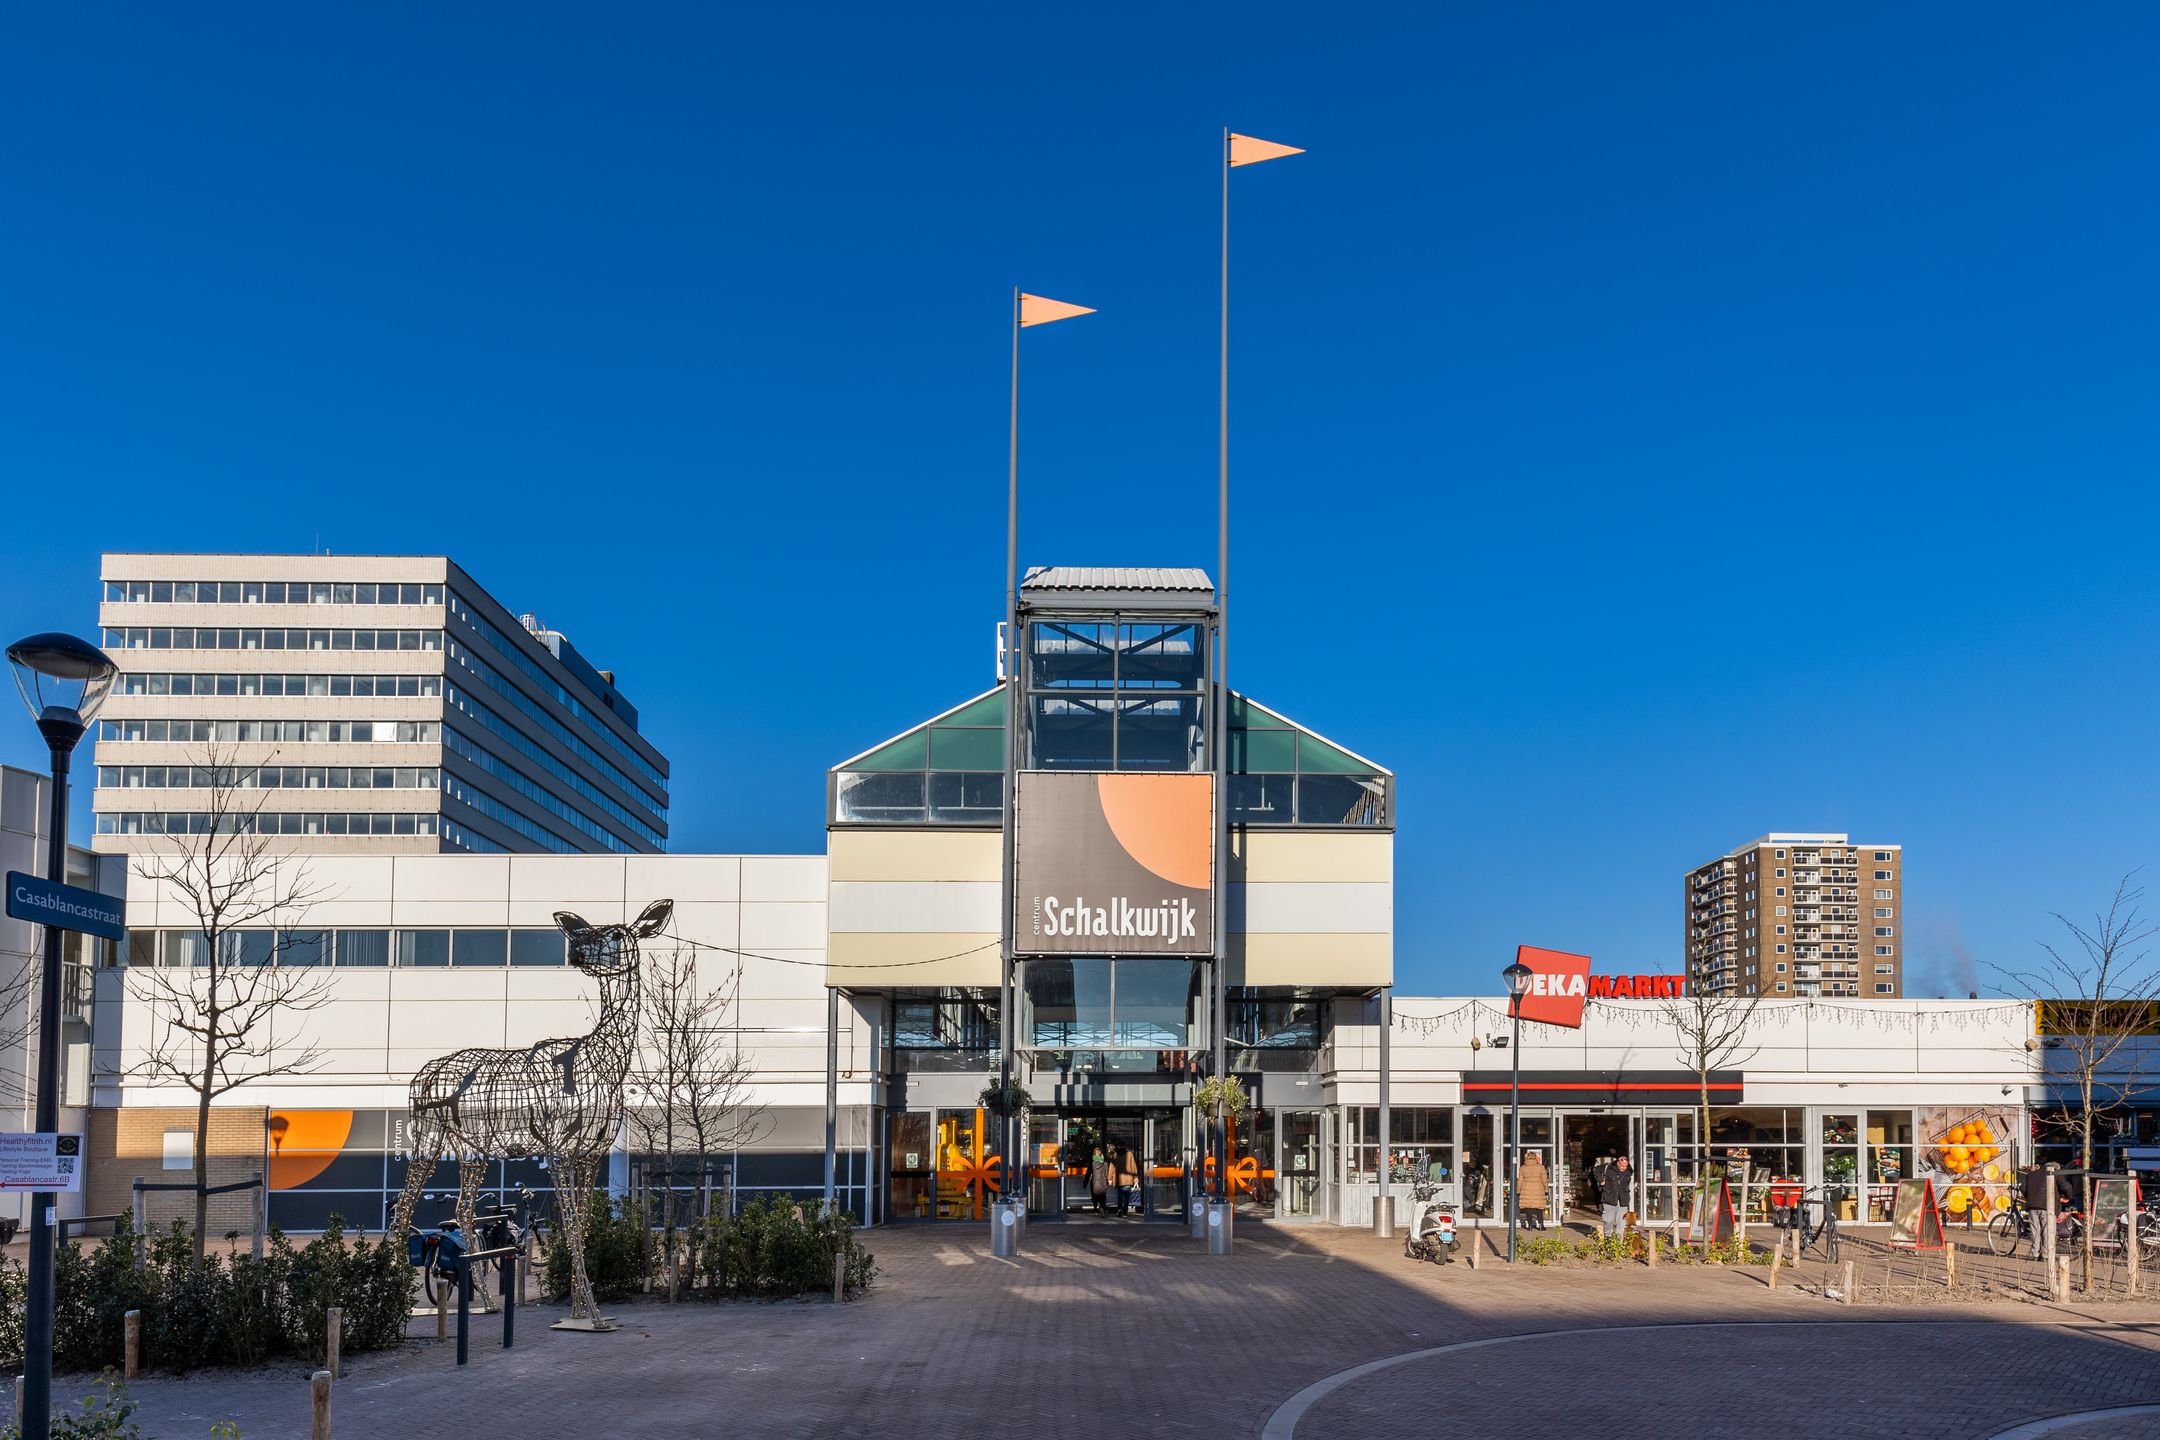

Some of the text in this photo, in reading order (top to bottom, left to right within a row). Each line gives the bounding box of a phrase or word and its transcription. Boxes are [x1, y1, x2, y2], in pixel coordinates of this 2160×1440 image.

[15, 886, 121, 925] Casablancastraat
[1043, 896, 1196, 945] Schalkwijk
[1587, 975, 1687, 998] MARKT
[393, 1119, 403, 1162] centrum
